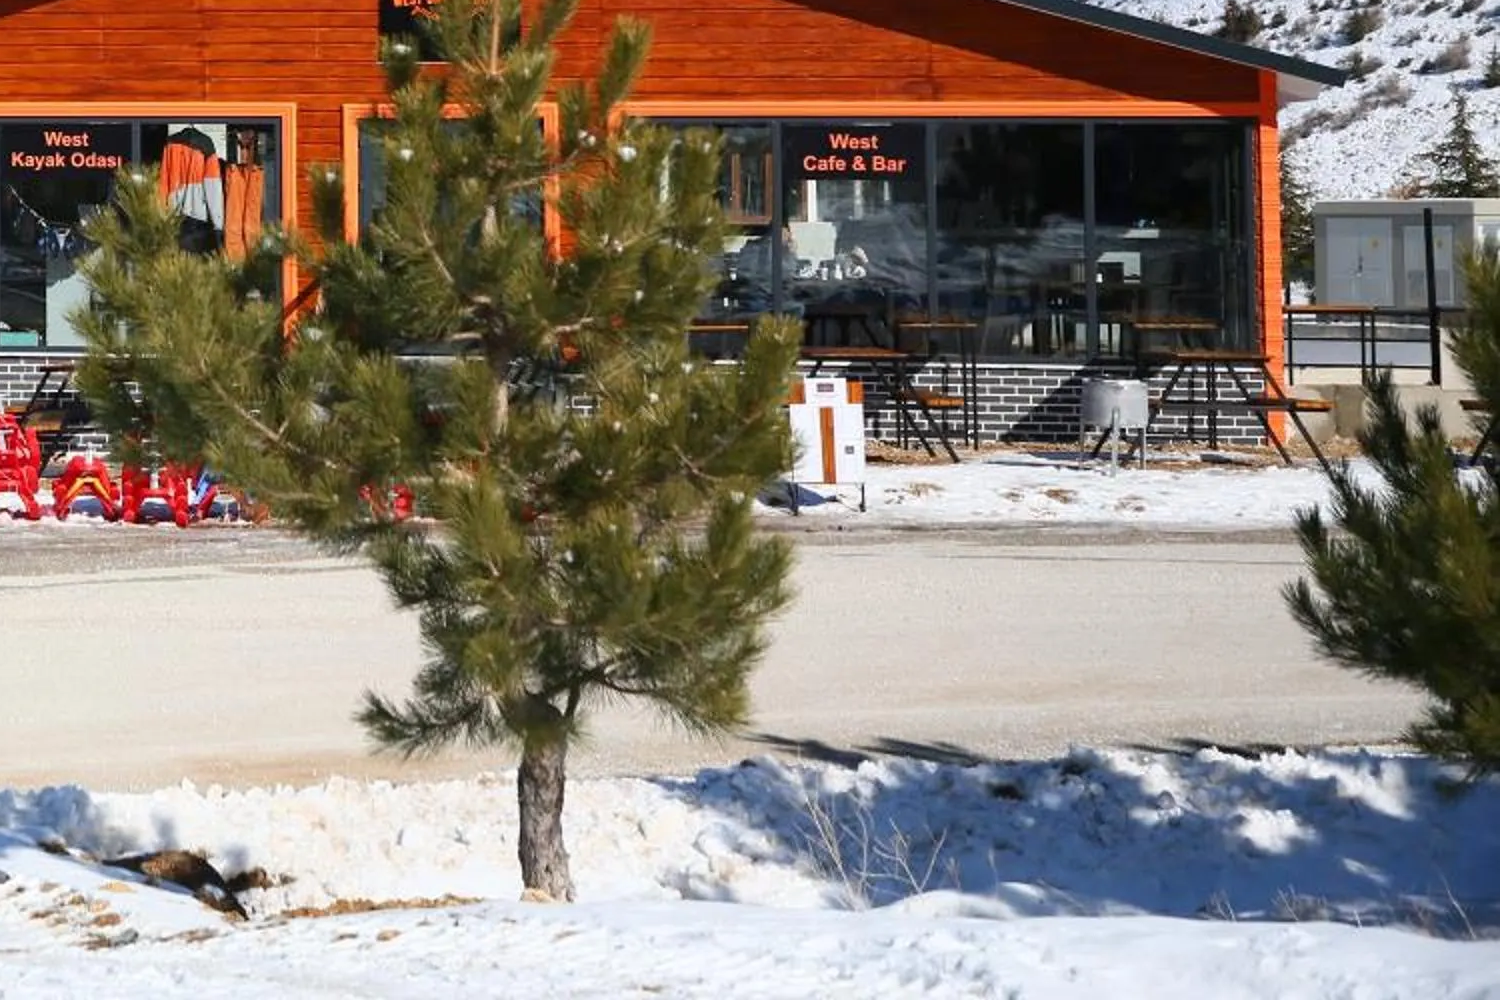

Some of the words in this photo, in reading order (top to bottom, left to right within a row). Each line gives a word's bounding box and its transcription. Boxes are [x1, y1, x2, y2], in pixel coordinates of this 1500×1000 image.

[44, 131, 89, 147] West
[829, 133, 879, 149] West
[11, 152, 65, 170] Kayak
[803, 155, 846, 171] Cafe
[852, 155, 866, 171] &
[873, 155, 906, 172] Bar
